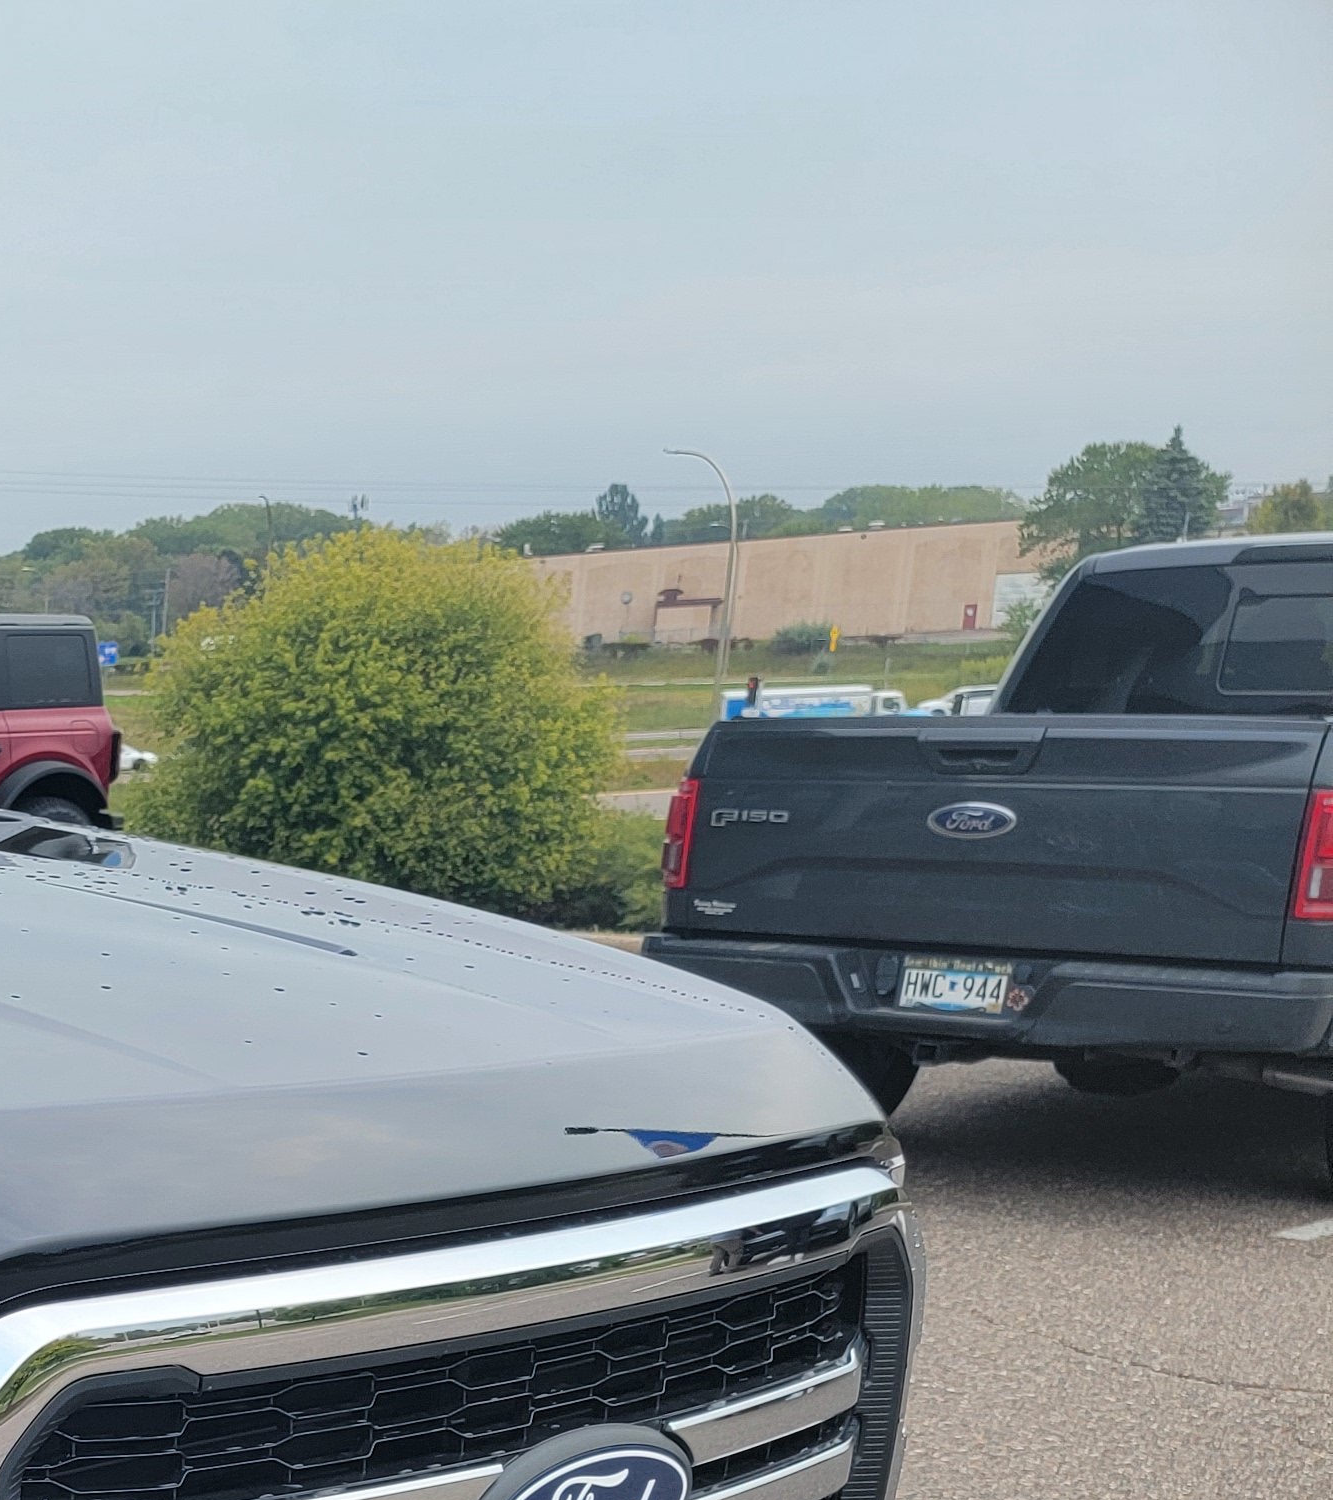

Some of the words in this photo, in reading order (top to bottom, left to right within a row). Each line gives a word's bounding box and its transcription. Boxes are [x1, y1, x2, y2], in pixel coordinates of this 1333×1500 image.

[946, 810, 995, 830] Ford
[904, 971, 946, 998] HWC
[963, 976, 1003, 1003] 944
